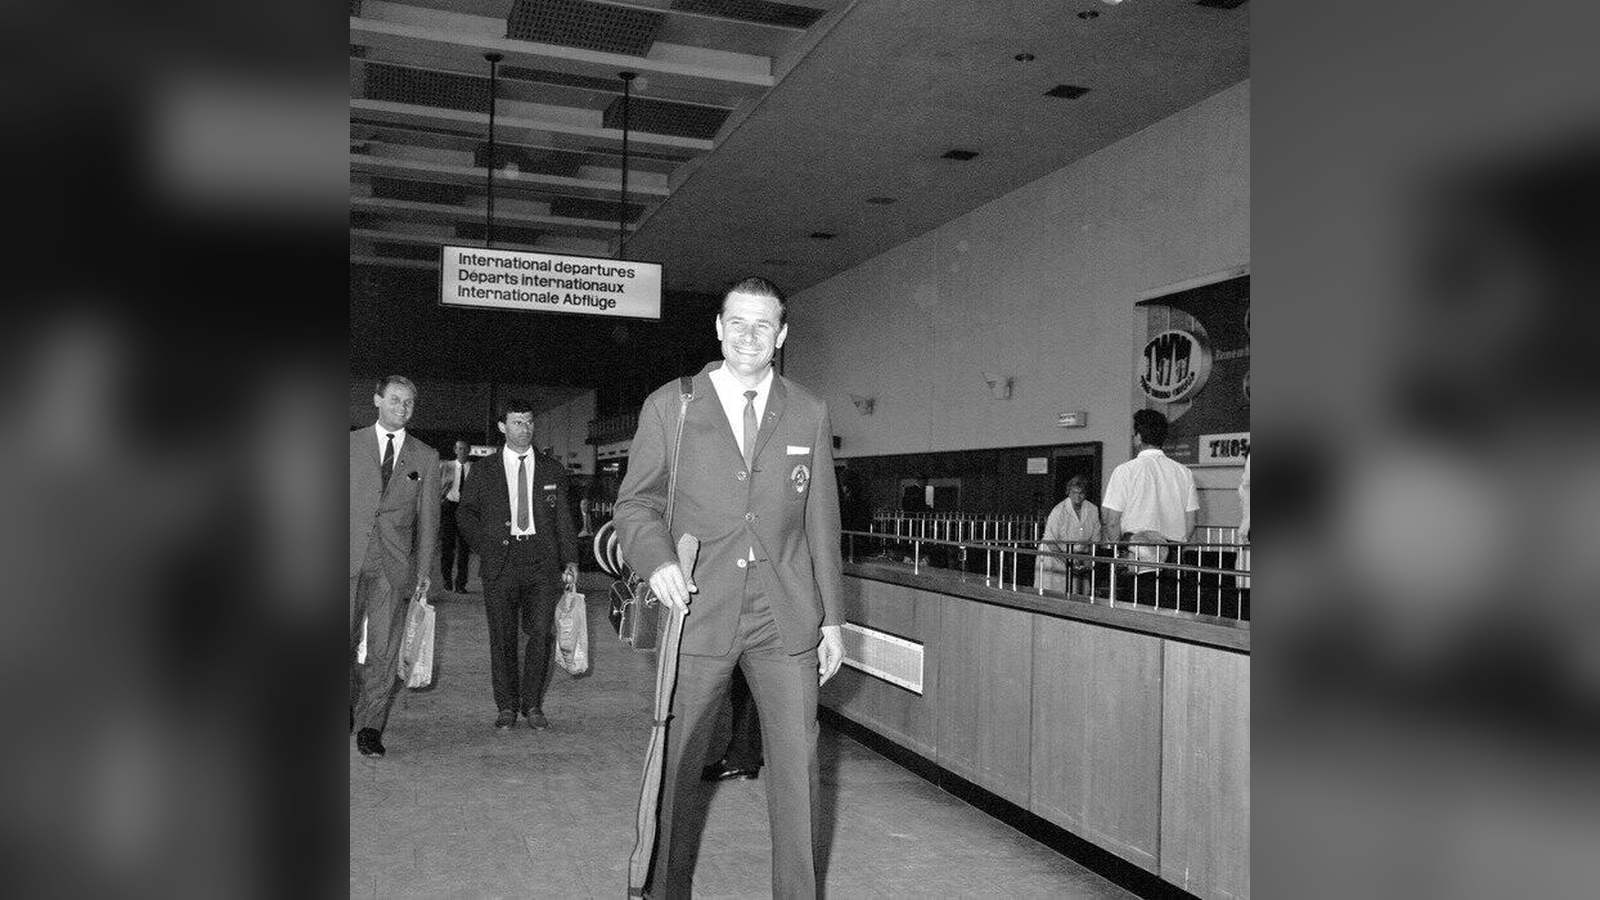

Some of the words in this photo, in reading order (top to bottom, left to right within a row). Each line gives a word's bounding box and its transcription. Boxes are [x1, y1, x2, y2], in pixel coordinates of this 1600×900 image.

[458, 252, 552, 272] International
[554, 261, 636, 279] departures
[458, 269, 519, 285] Départs
[521, 273, 625, 294] internationaux
[458, 284, 560, 305] Internationale
[563, 292, 617, 311] Abflüge
